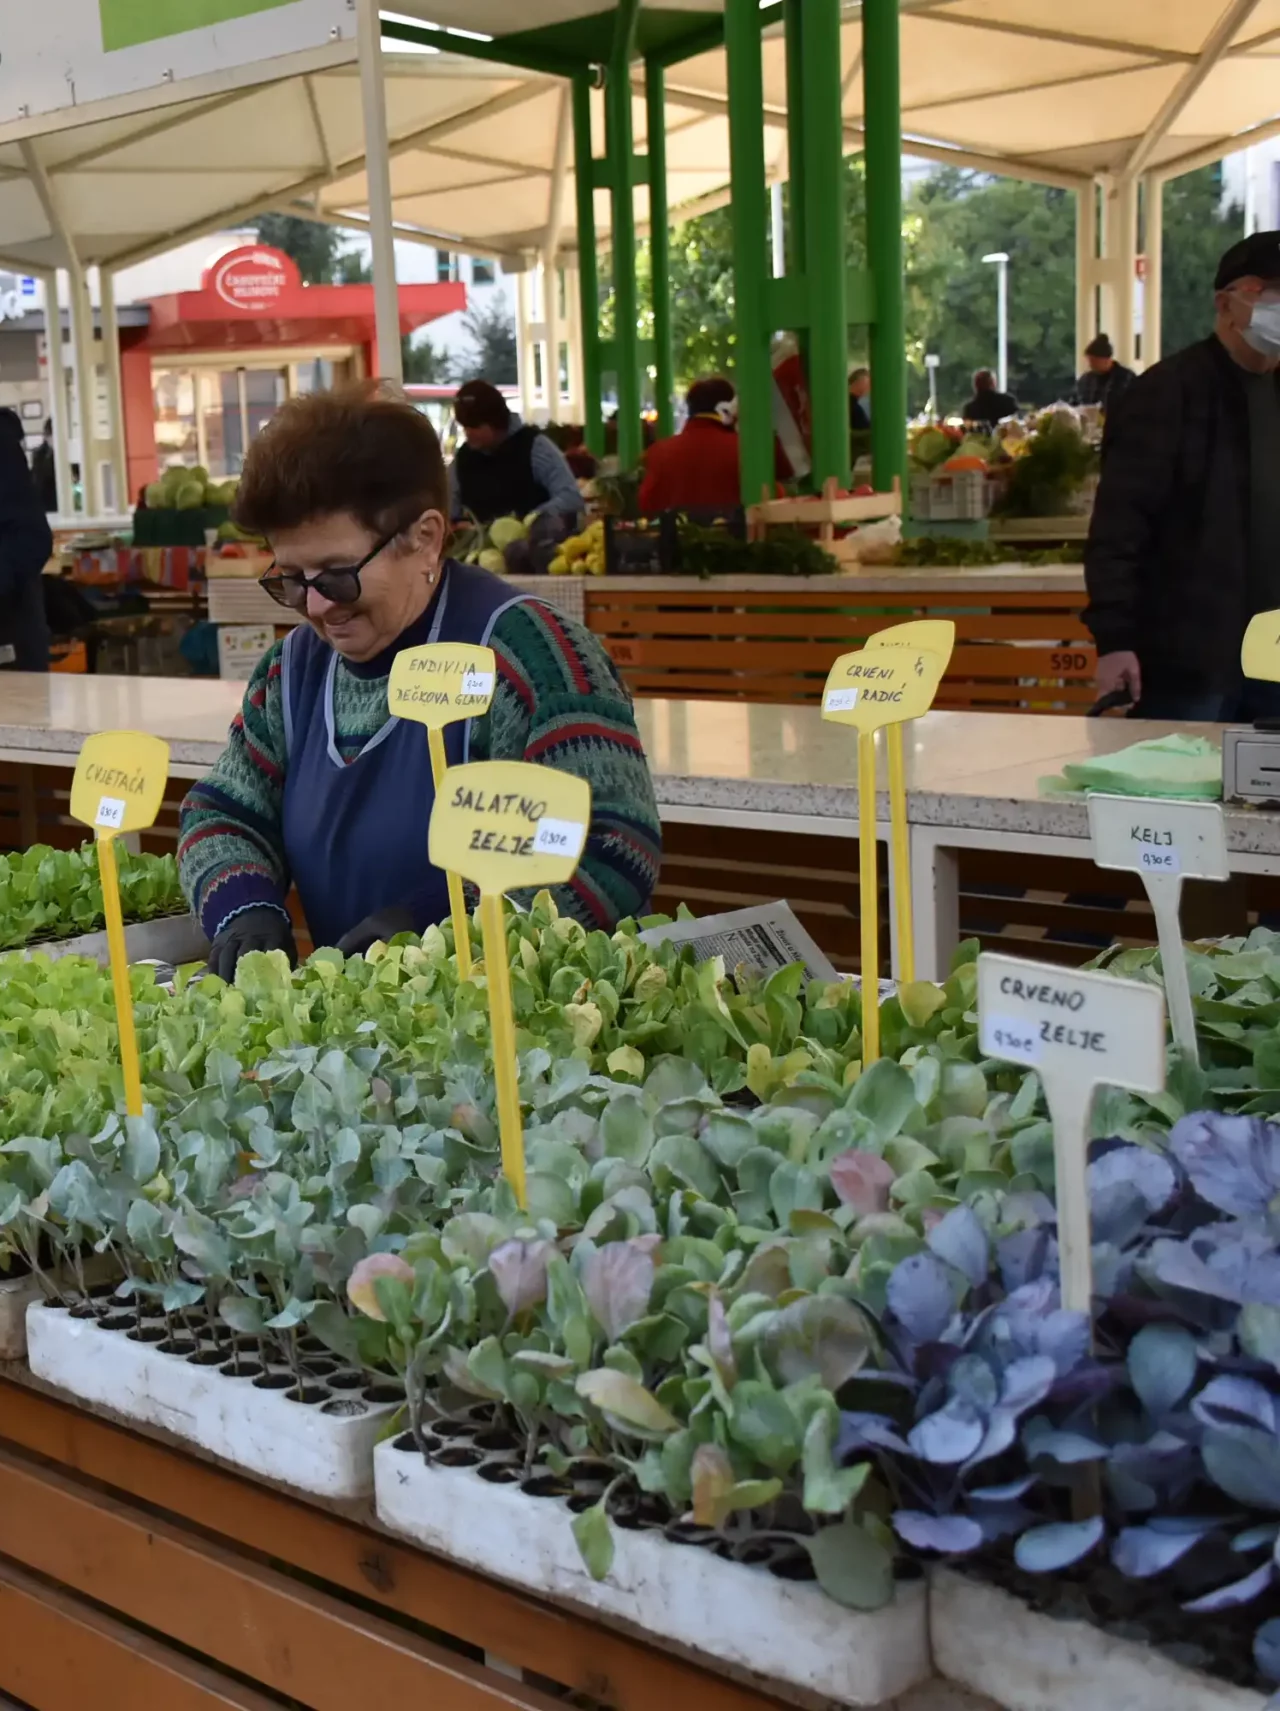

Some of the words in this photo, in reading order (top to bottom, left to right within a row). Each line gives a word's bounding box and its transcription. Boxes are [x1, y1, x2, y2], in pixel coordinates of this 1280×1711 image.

[409, 658, 476, 676] ENDIVIJA
[846, 664, 894, 680] CRVENI
[861, 682, 906, 702] RADIĆ
[451, 786, 548, 822] SALATNO
[469, 829, 535, 856] ZELJE
[1130, 825, 1173, 846] KELJ
[1000, 977, 1085, 1012] CRVENO
[1040, 1020, 1107, 1053] ZELJE
